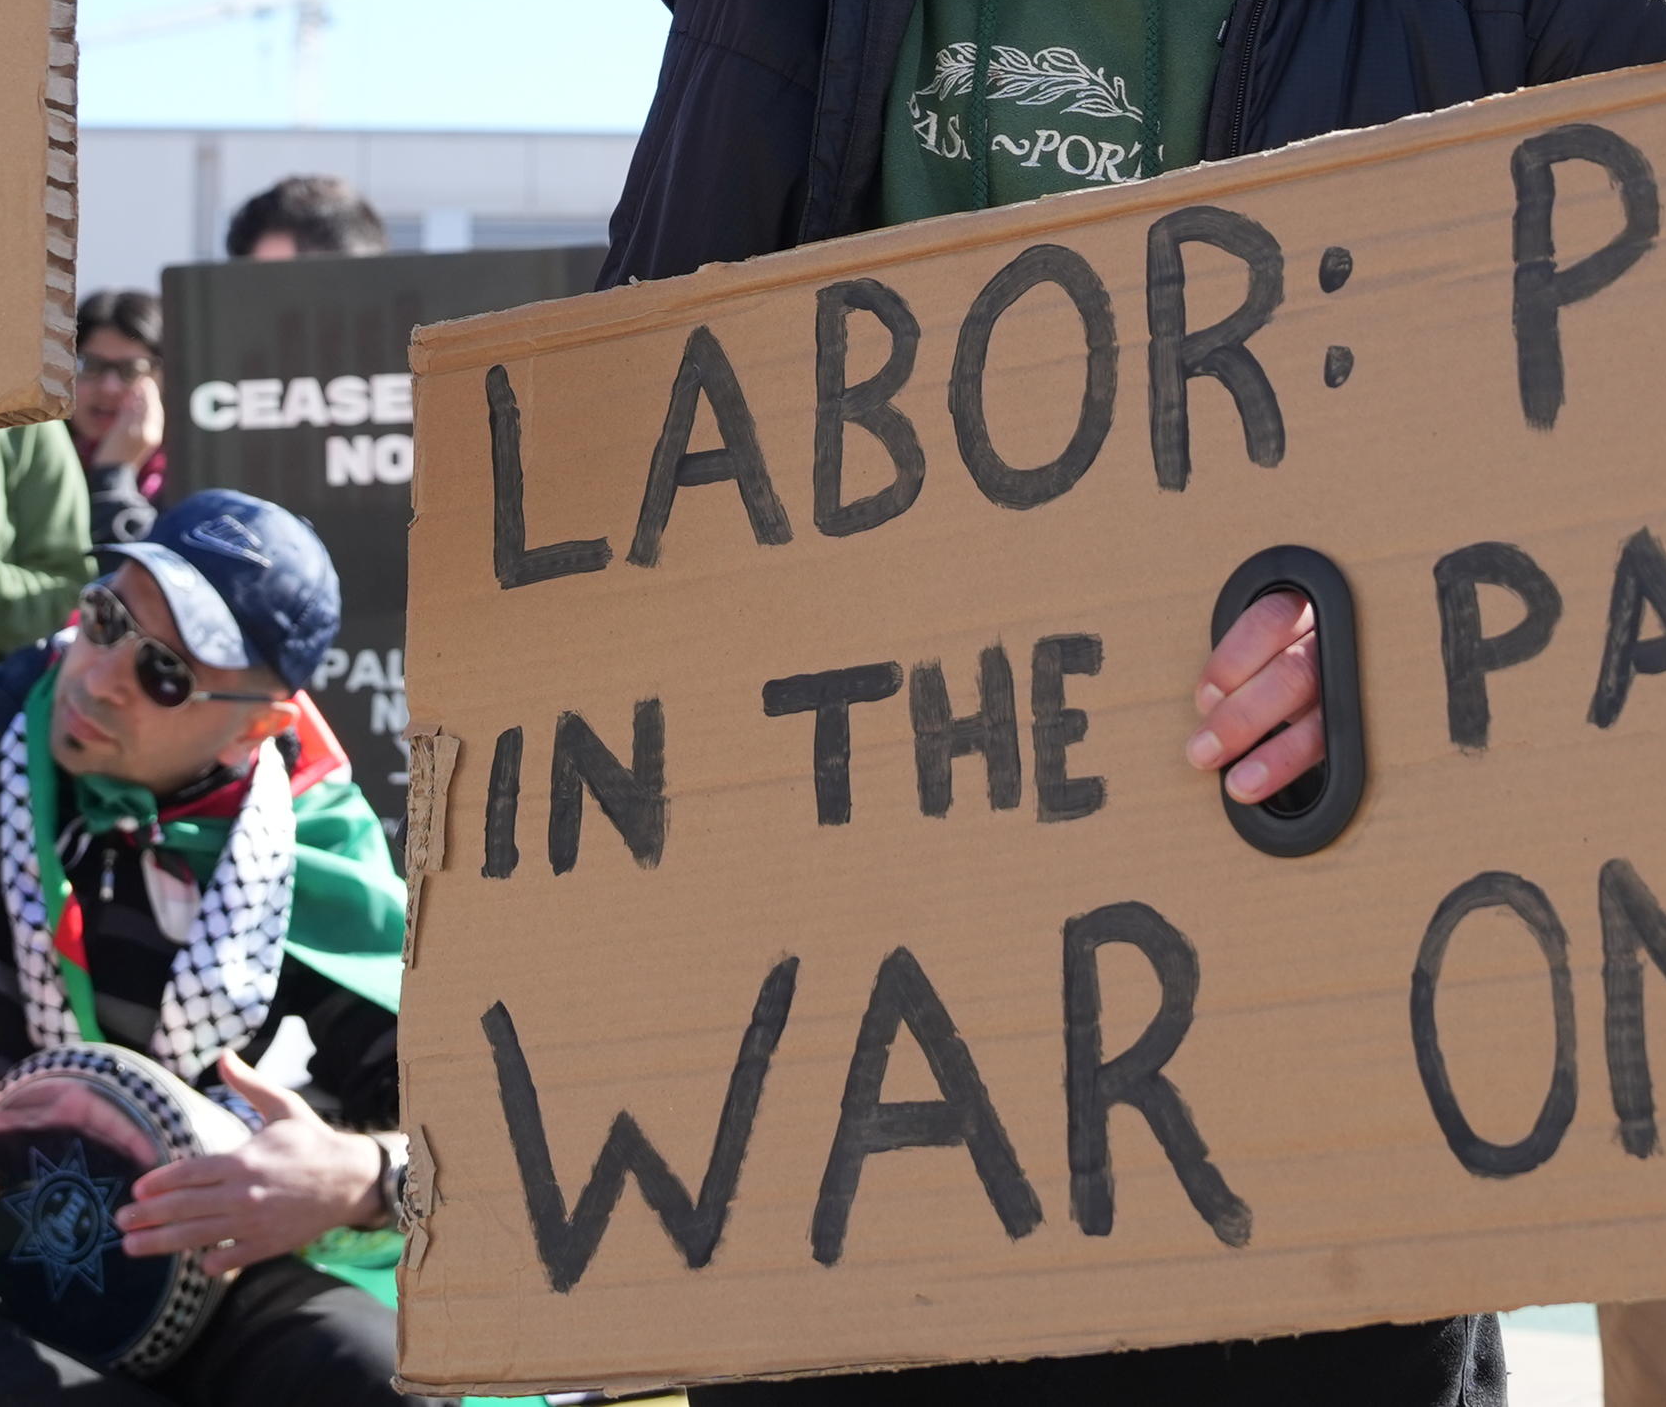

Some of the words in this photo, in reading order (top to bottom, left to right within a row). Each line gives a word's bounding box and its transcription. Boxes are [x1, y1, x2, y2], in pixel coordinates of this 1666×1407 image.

[484, 205, 1353, 590] LABOR:
[480, 697, 668, 879] IN
[762, 633, 1108, 826] THE
[480, 900, 1253, 1295] WAR
